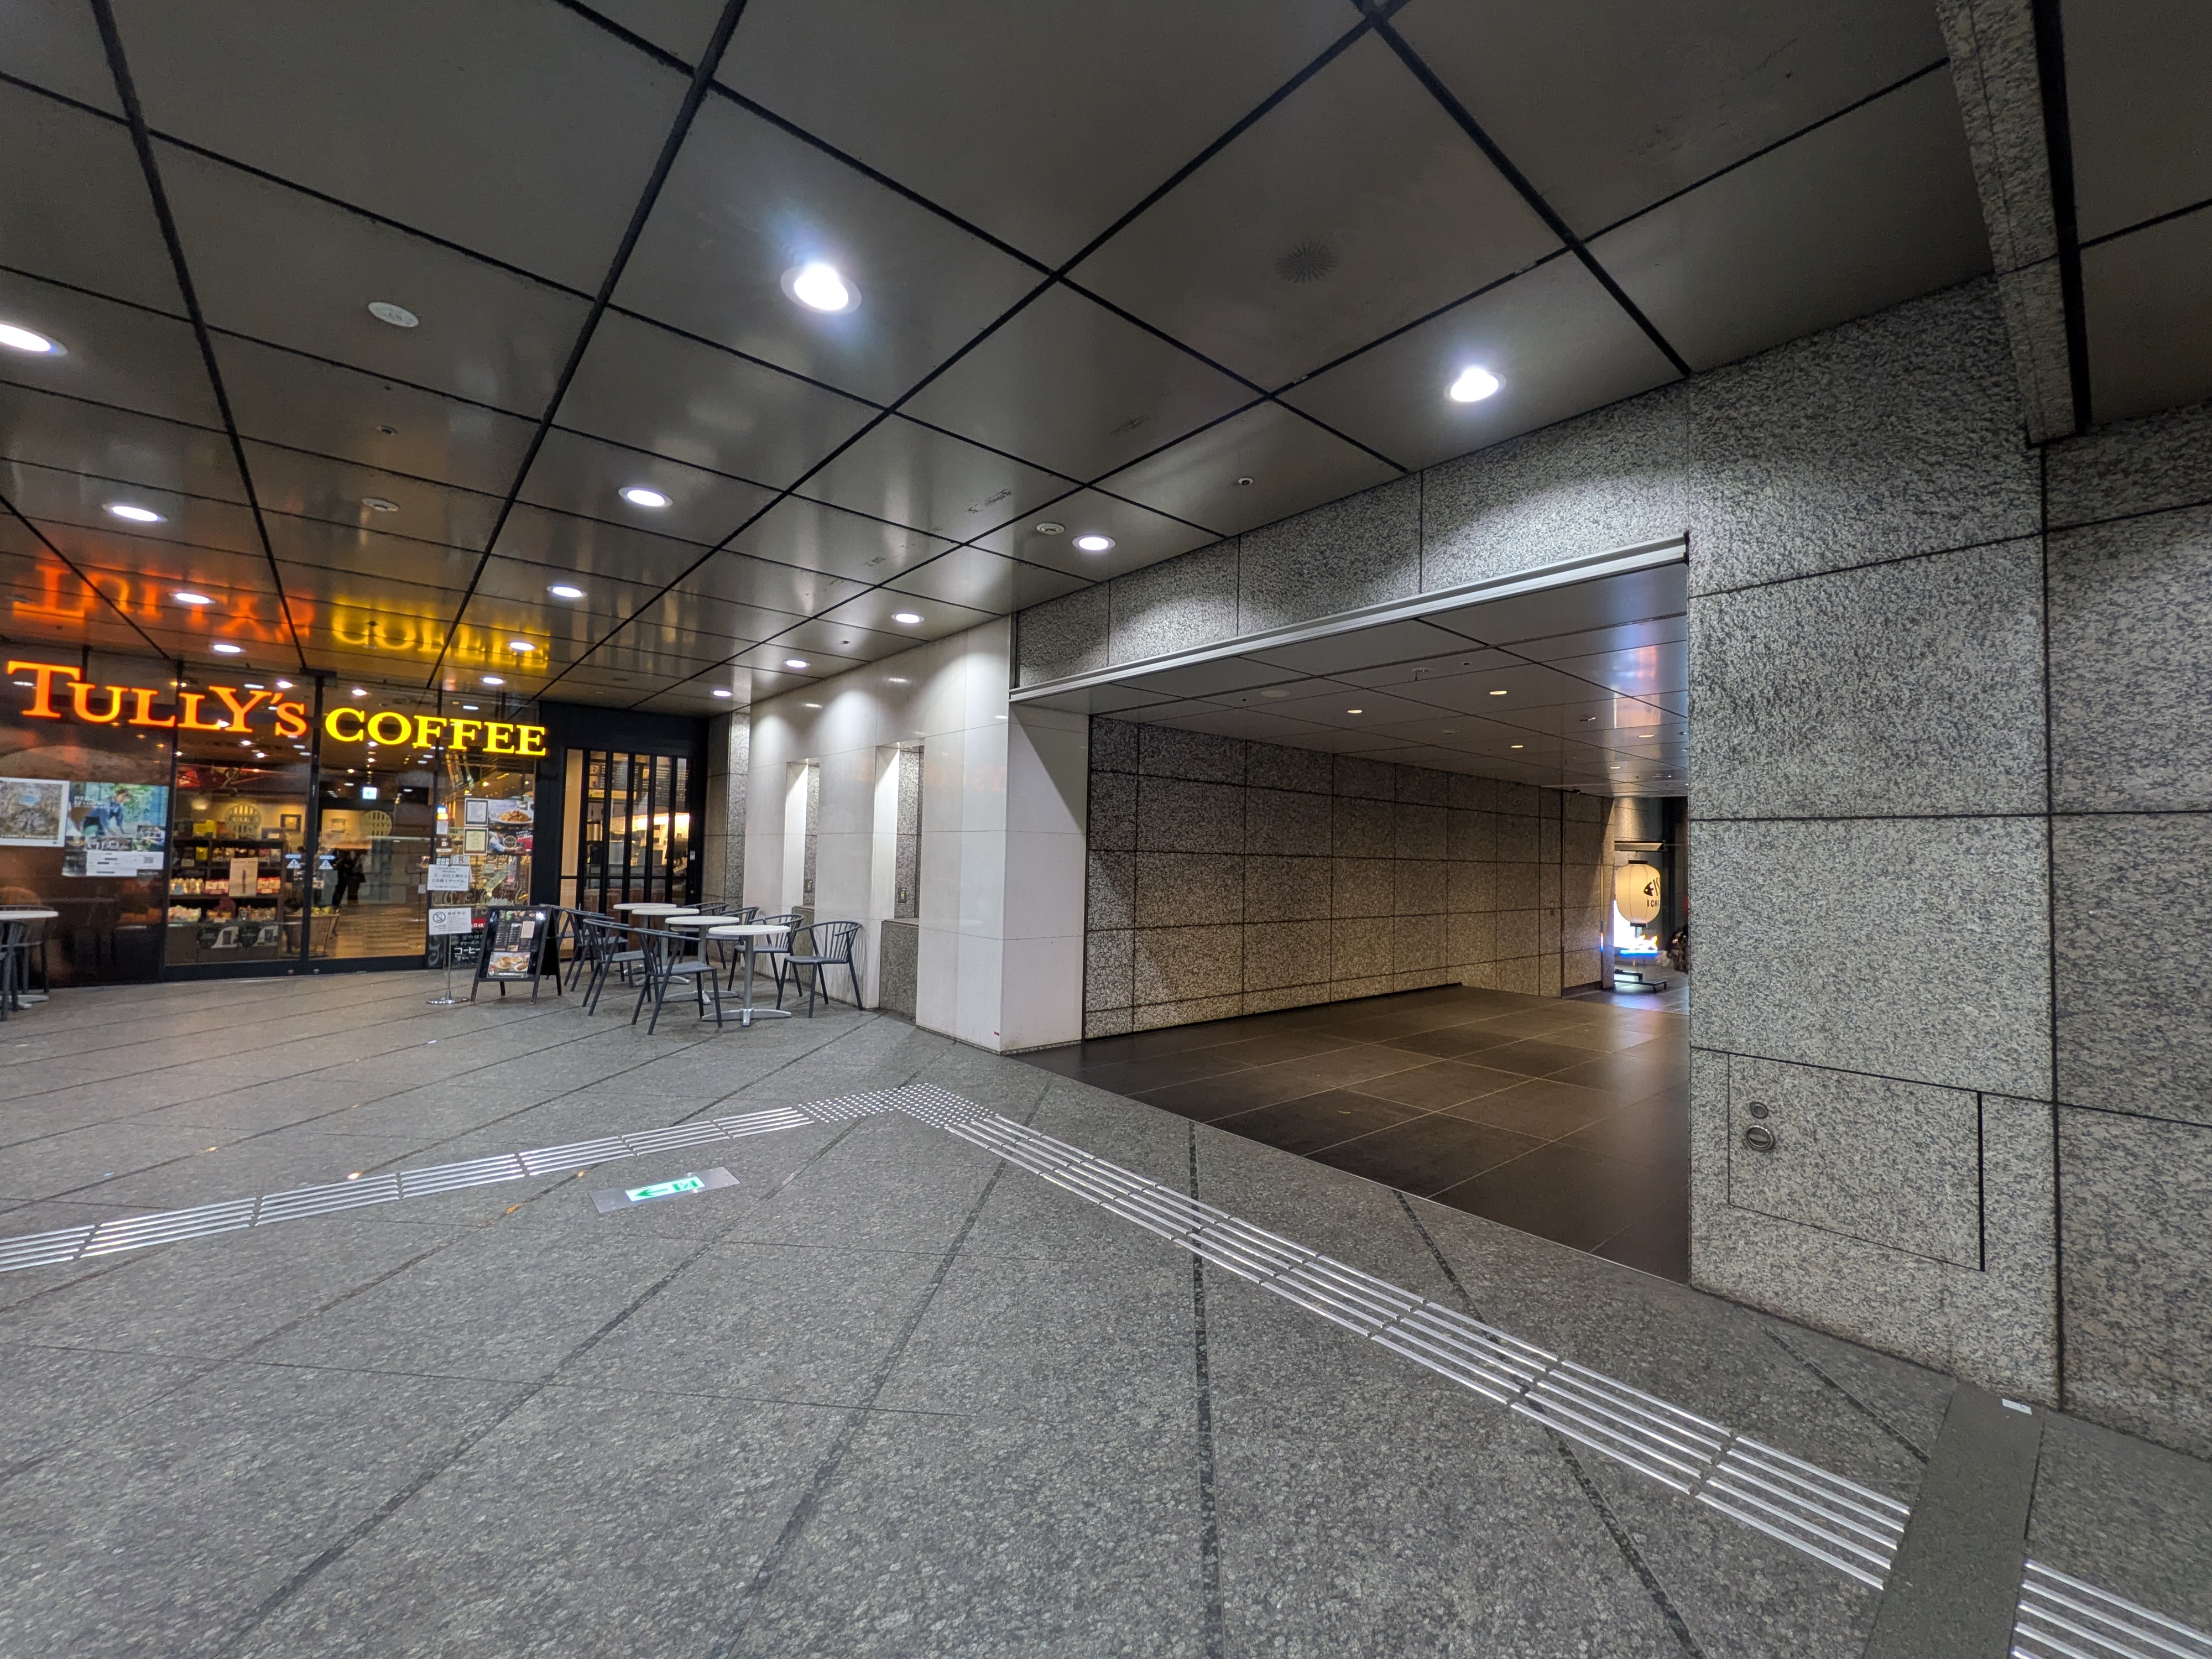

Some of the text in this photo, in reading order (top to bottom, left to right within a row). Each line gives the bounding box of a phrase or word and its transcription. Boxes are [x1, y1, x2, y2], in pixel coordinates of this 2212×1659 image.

[325, 707, 547, 756] COFFEE
[454, 946, 481, 955] コーヒー
